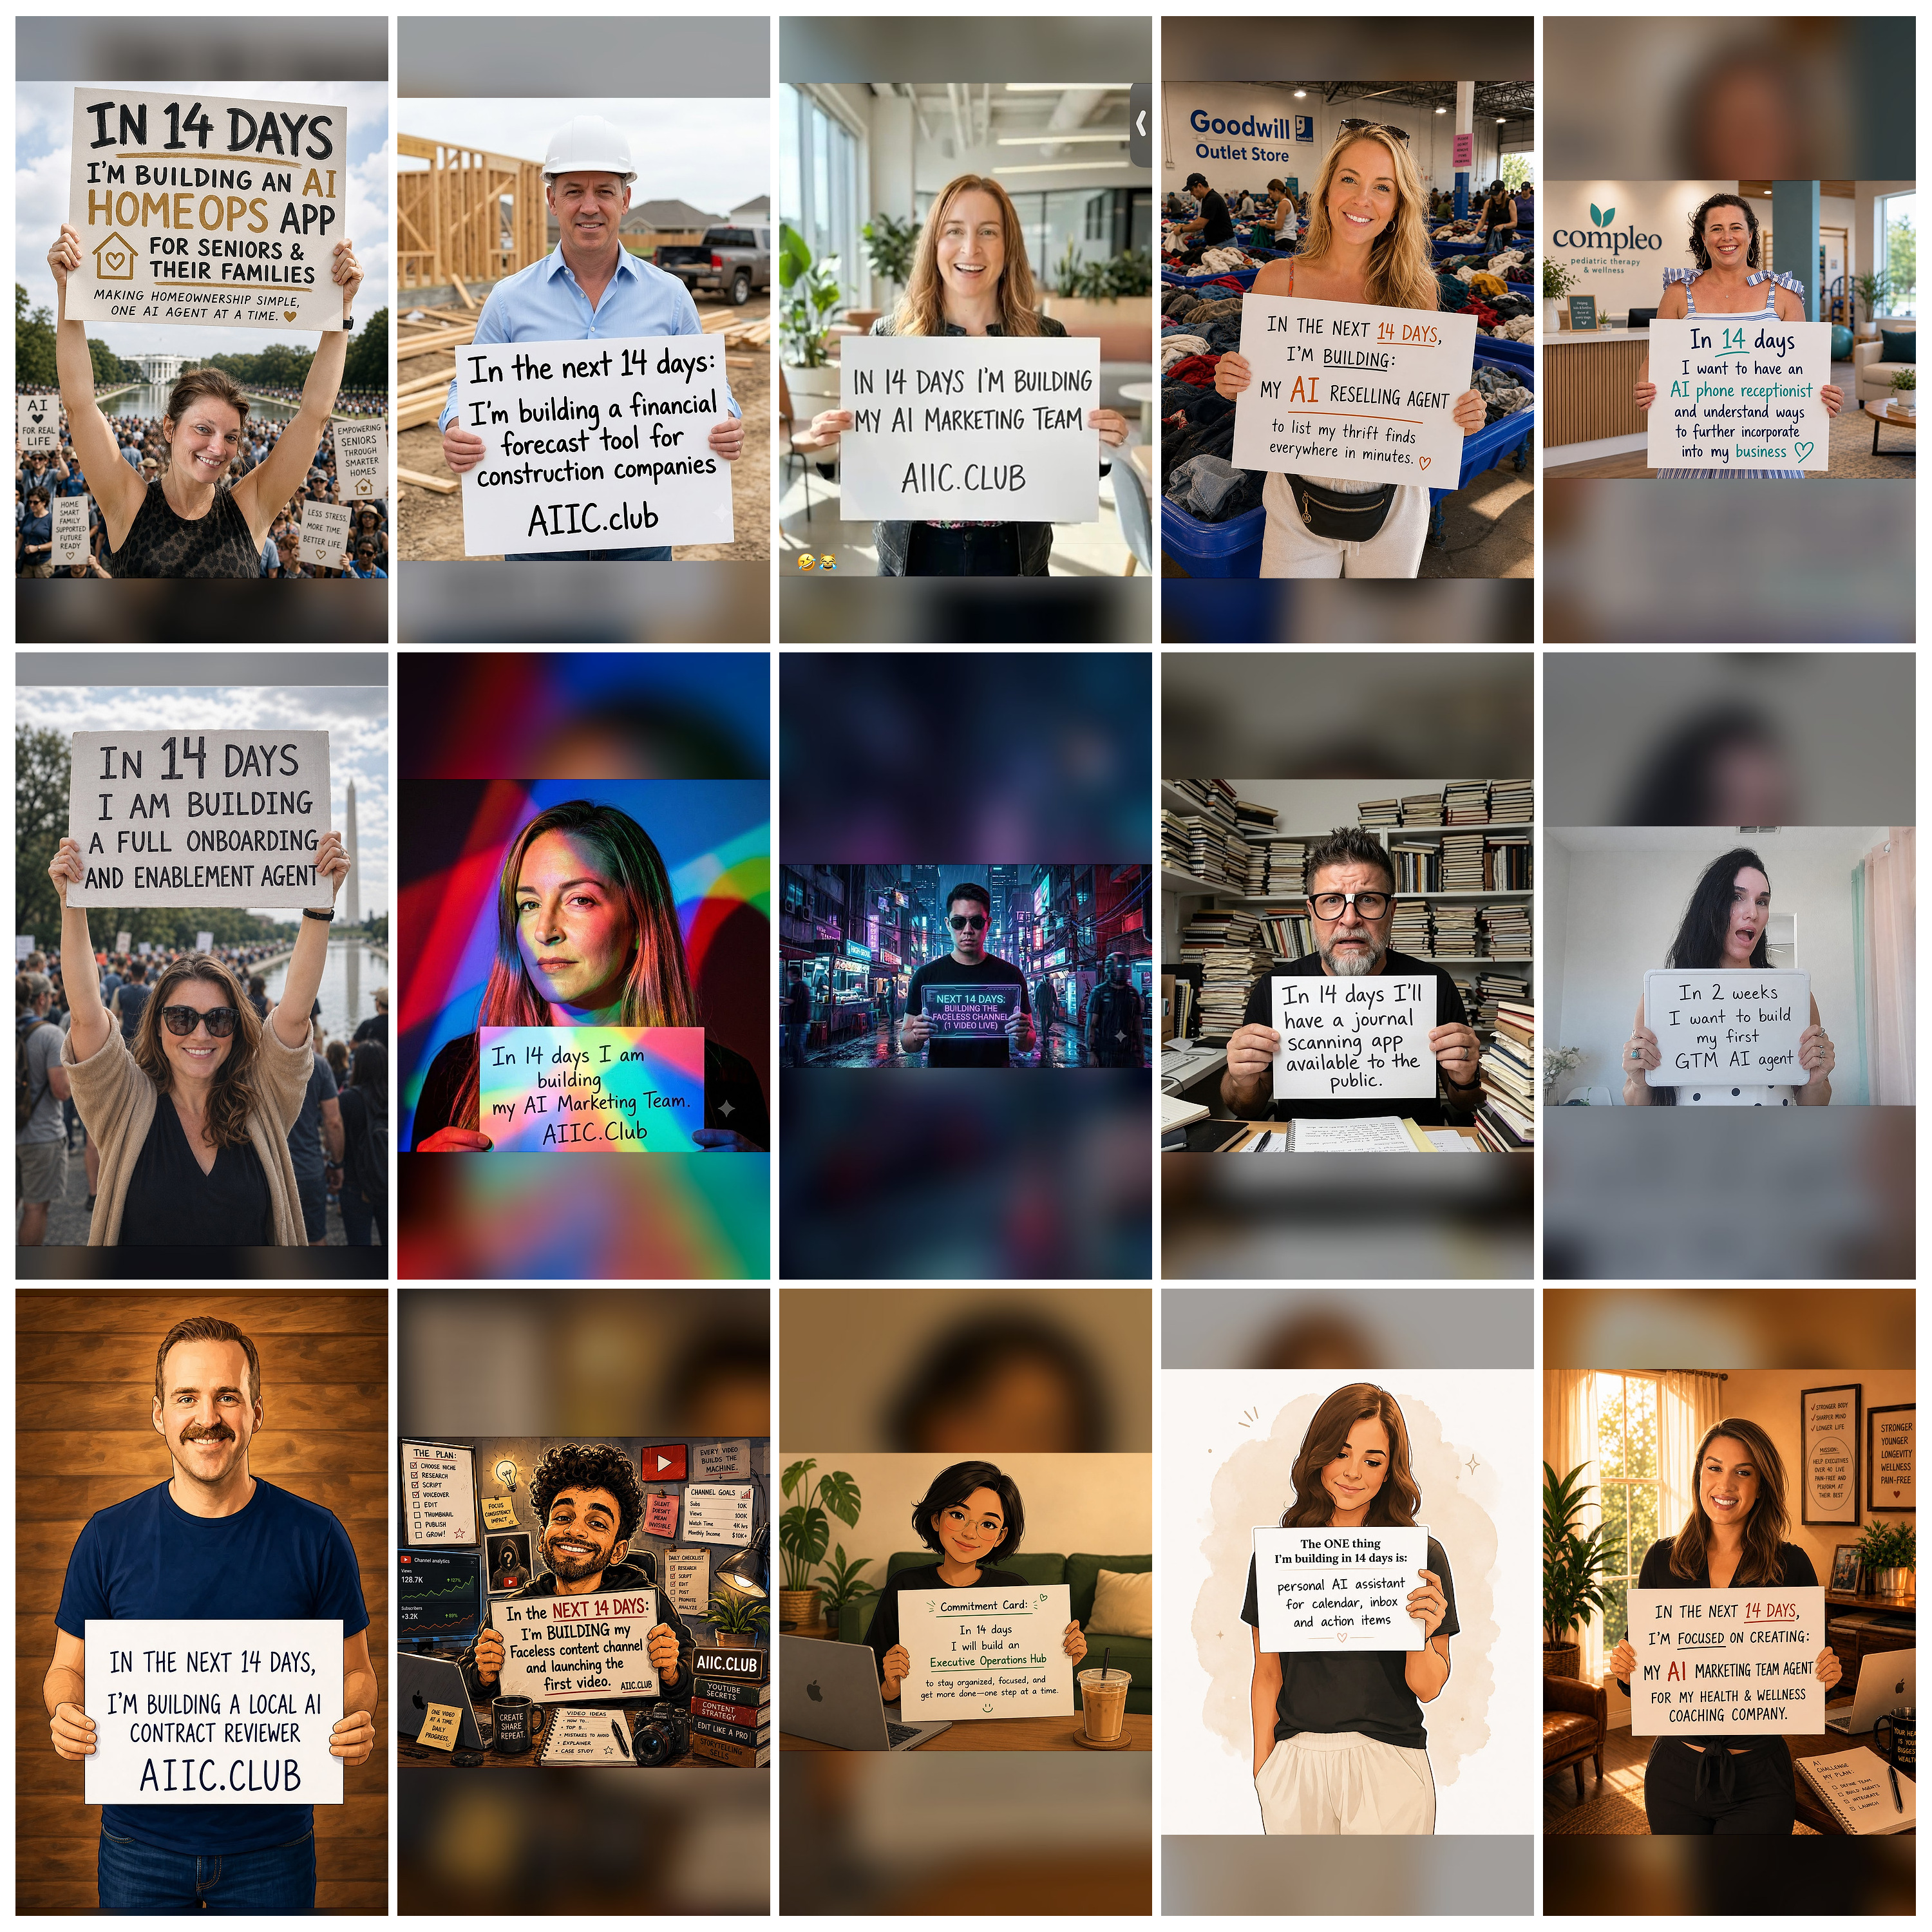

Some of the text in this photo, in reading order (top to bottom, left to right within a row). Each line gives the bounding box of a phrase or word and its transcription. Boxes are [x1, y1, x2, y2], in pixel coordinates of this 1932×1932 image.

[1190, 109, 1289, 139] Goodwill
[86, 102, 333, 160] IN 14 DAYS
[1196, 144, 1289, 162] Outlet Store
[1553, 225, 1662, 256] compleo
[1571, 257, 1640, 267] pediatric therapy
[468, 347, 714, 384] In the next 14 days:
[28, 399, 48, 412] AI
[855, 406, 1083, 433] MY AI MARKETING TEAM
[337, 424, 381, 435] EMPOWERING
[28, 437, 50, 446] LIFE
[341, 435, 376, 446] SENIORS
[344, 447, 377, 457] THROUGH
[1270, 441, 1413, 464] everywhere in minutes.
[346, 457, 379, 467] SMARTER
[350, 467, 376, 477] HOMES
[477, 456, 716, 487] construction companies
[902, 462, 1026, 493] AIIC.CLUB
[308, 509, 347, 522] LESS STRESS.
[528, 500, 658, 537] AIIC.club
[307, 522, 341, 535] MORE TIME.
[303, 535, 342, 549] BETTER LIFE.
[84, 864, 318, 889] AND ENABLEMENT AGENT
[937, 995, 1005, 1003] NEXT 14 DAYS:
[1282, 983, 1421, 1010] In 14 days I'll
[944, 1021, 951, 1030] (1
[979, 1021, 998, 1030] LIVE)
[1676, 1049, 1794, 1071] GTM AI agent
[493, 1091, 690, 1122] my AI Marketing Team.
[1881, 1423, 1913, 1432] STRONGER
[1881, 1436, 1908, 1446] YOUNGER
[436, 1450, 456, 1459] PLAN:
[1881, 1450, 1913, 1459] LONGEVITY
[706, 1464, 738, 1473] MACHINE.
[1881, 1463, 1911, 1472] WELLNESS
[485, 1509, 511, 1517] CONSISTENCY
[1278, 1577, 1405, 1596] personal AI assistant
[941, 1599, 1027, 1611] Commitment Card:
[697, 1655, 757, 1672] AIIC.CLUB
[706, 1690, 736, 1700] SECRETS
[708, 1683, 741, 1694] YOUTUBE
[702, 1701, 735, 1713] CONTENT
[702, 1709, 736, 1721] STRATEGY
[1669, 1707, 1787, 1722] COACHING COMPANY.
[130, 1723, 301, 1743] CONTRACT REVIEWER
[698, 1721, 711, 1730] EDIT
[713, 1725, 726, 1734] LIKE
[735, 1730, 748, 1739] PRO
[700, 1738, 744, 1757] STORYTELLING
[710, 1748, 729, 1760] SELLS
[140, 1758, 301, 1791] AIIC.CLUB
[1817, 1763, 1849, 1773] CHALLENGE
